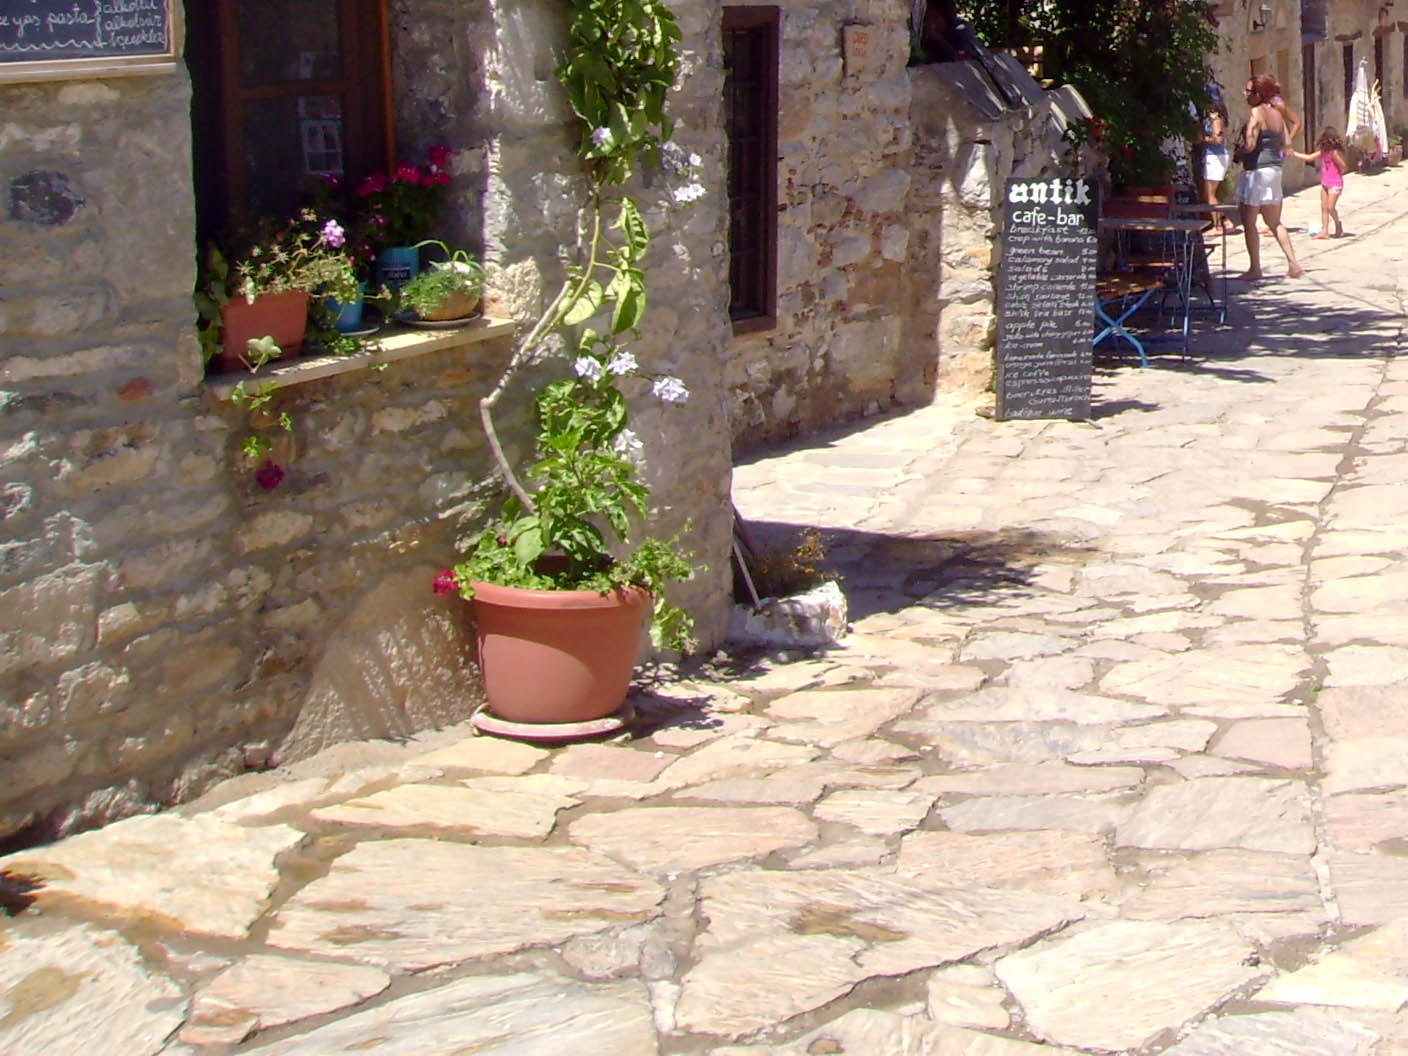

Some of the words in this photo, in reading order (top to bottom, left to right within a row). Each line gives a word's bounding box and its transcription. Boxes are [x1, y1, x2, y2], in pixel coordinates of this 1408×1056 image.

[47, 3, 95, 32] pasta
[1009, 178, 1092, 205] antik
[1012, 206, 1085, 226] cafe-bar
